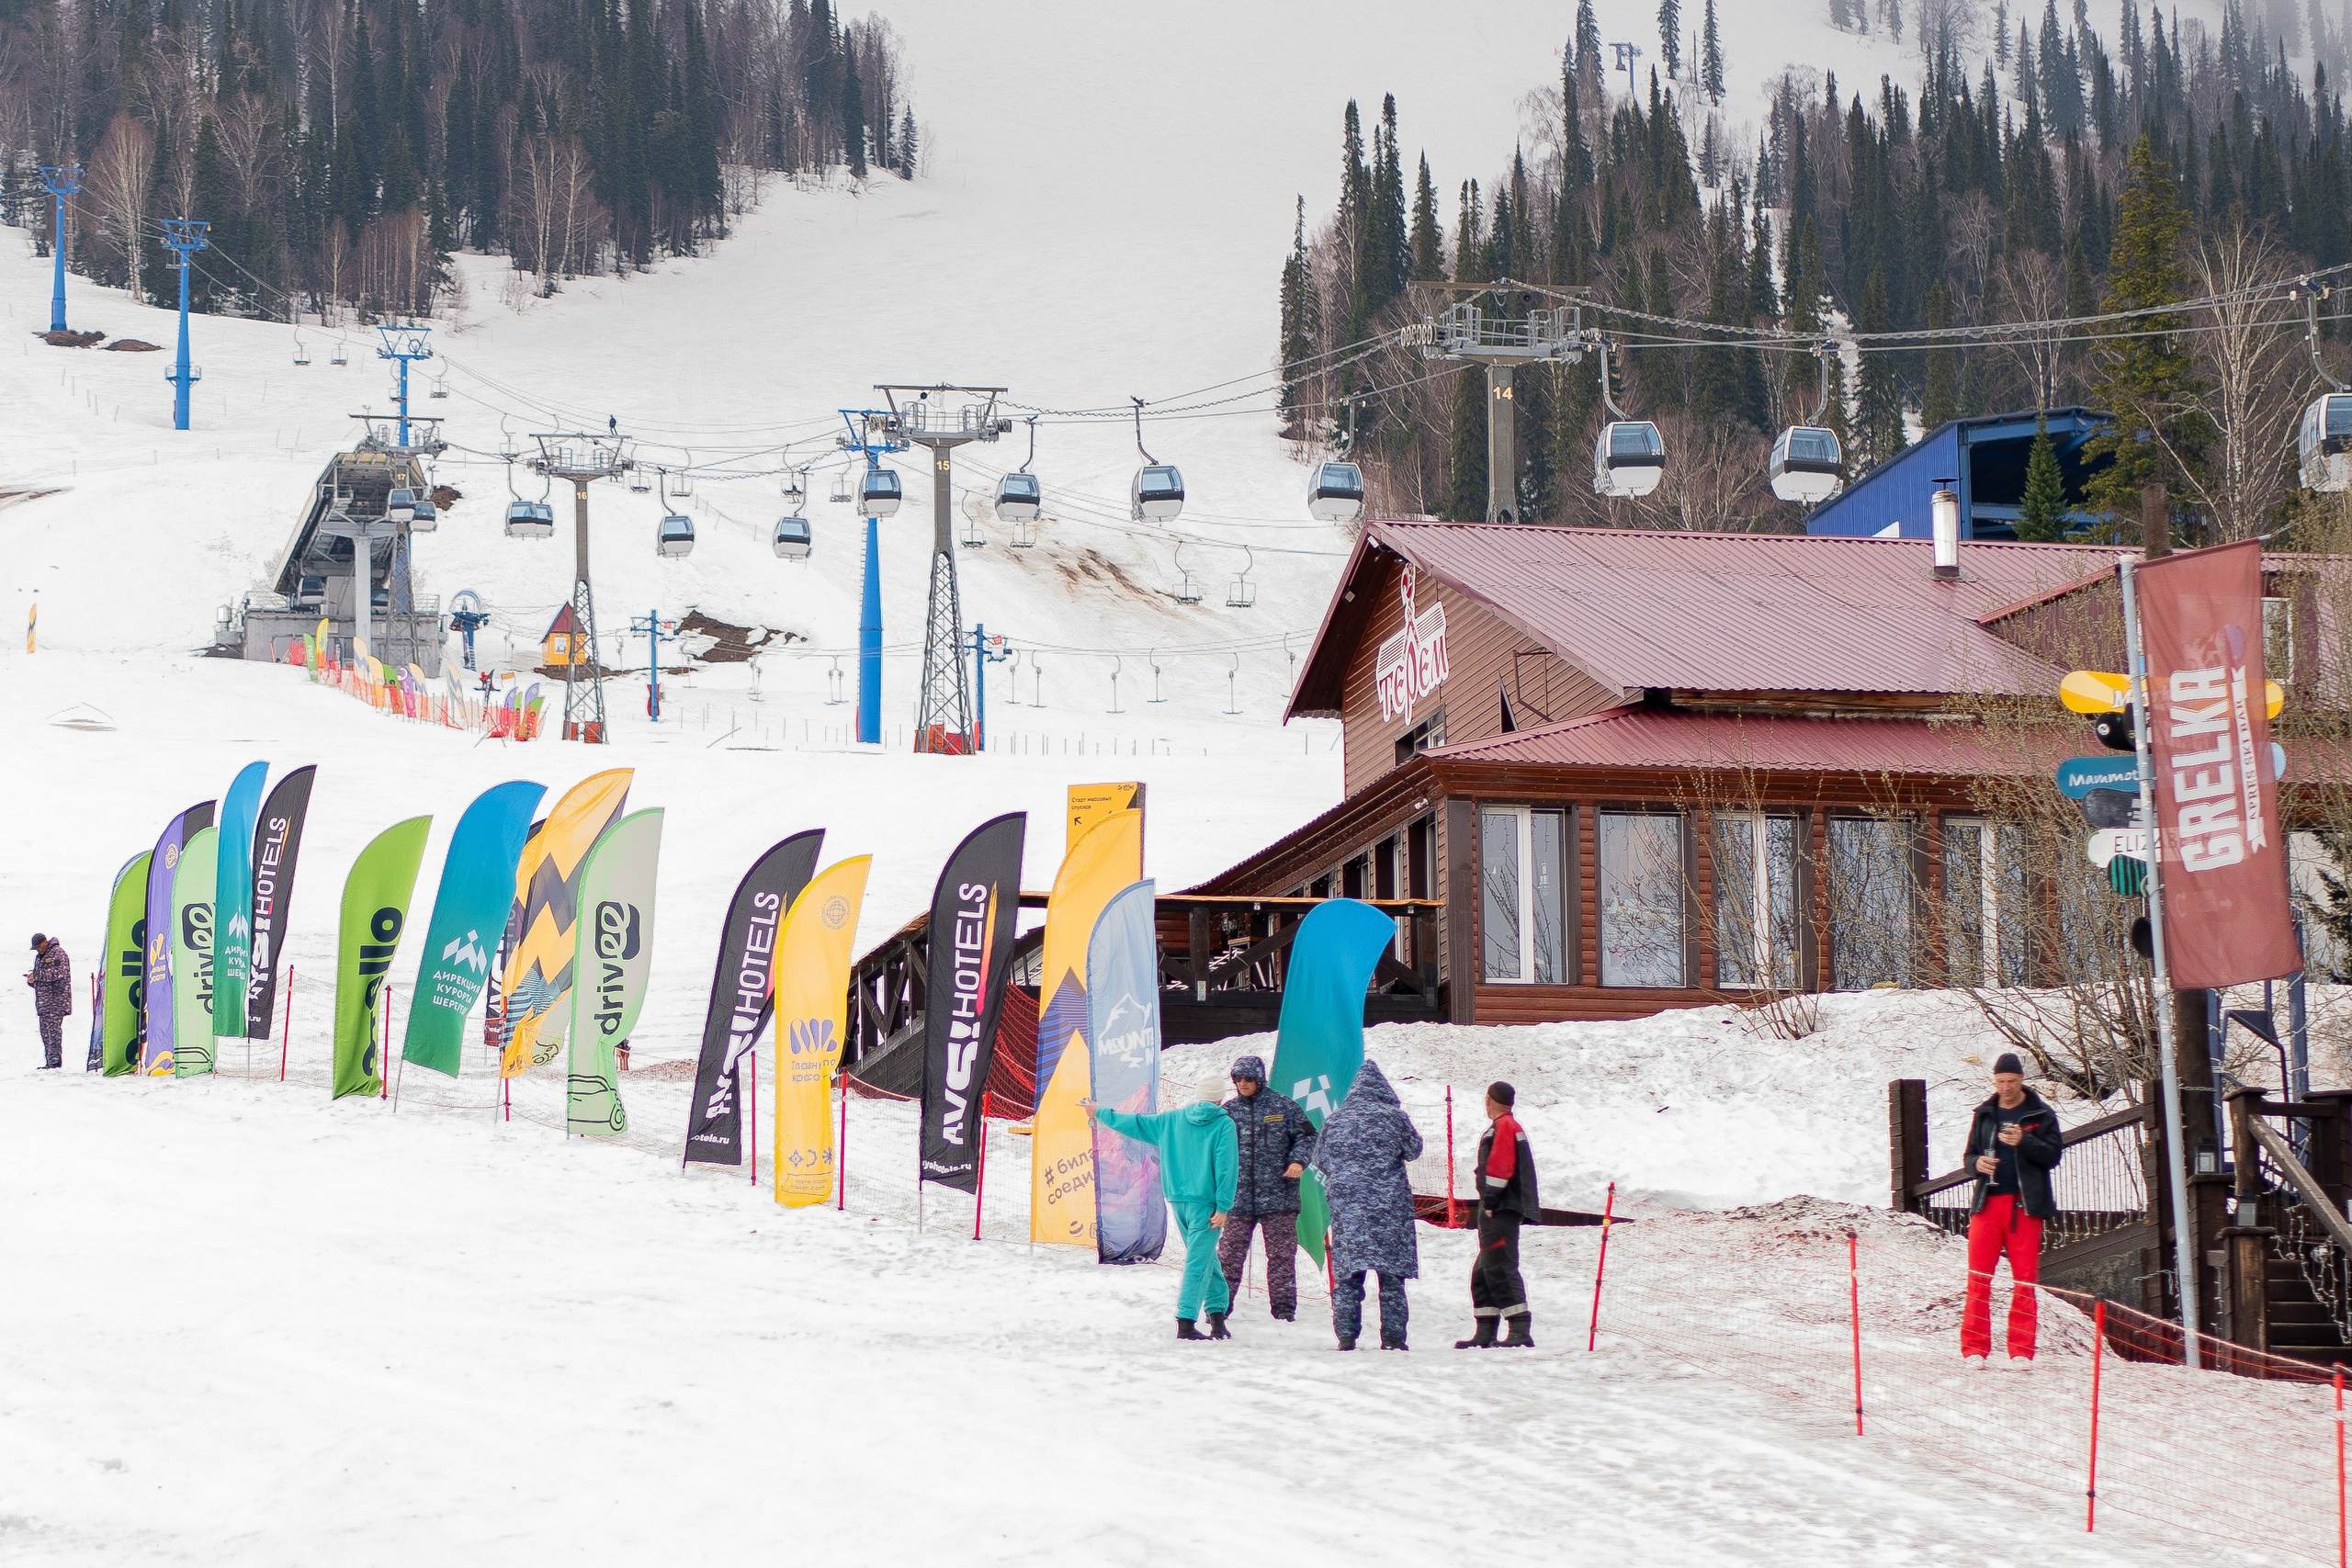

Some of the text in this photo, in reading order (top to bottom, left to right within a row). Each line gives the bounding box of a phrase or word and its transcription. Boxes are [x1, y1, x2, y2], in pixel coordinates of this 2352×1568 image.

[1493, 386, 1513, 400] 14
[937, 460, 950, 471] 15
[577, 491, 587, 500] 16
[2069, 769, 2139, 787] Mammot
[2169, 666, 2245, 873] GRELKA
[952, 883, 989, 1018] HOTELS
[594, 901, 640, 1036] drivee
